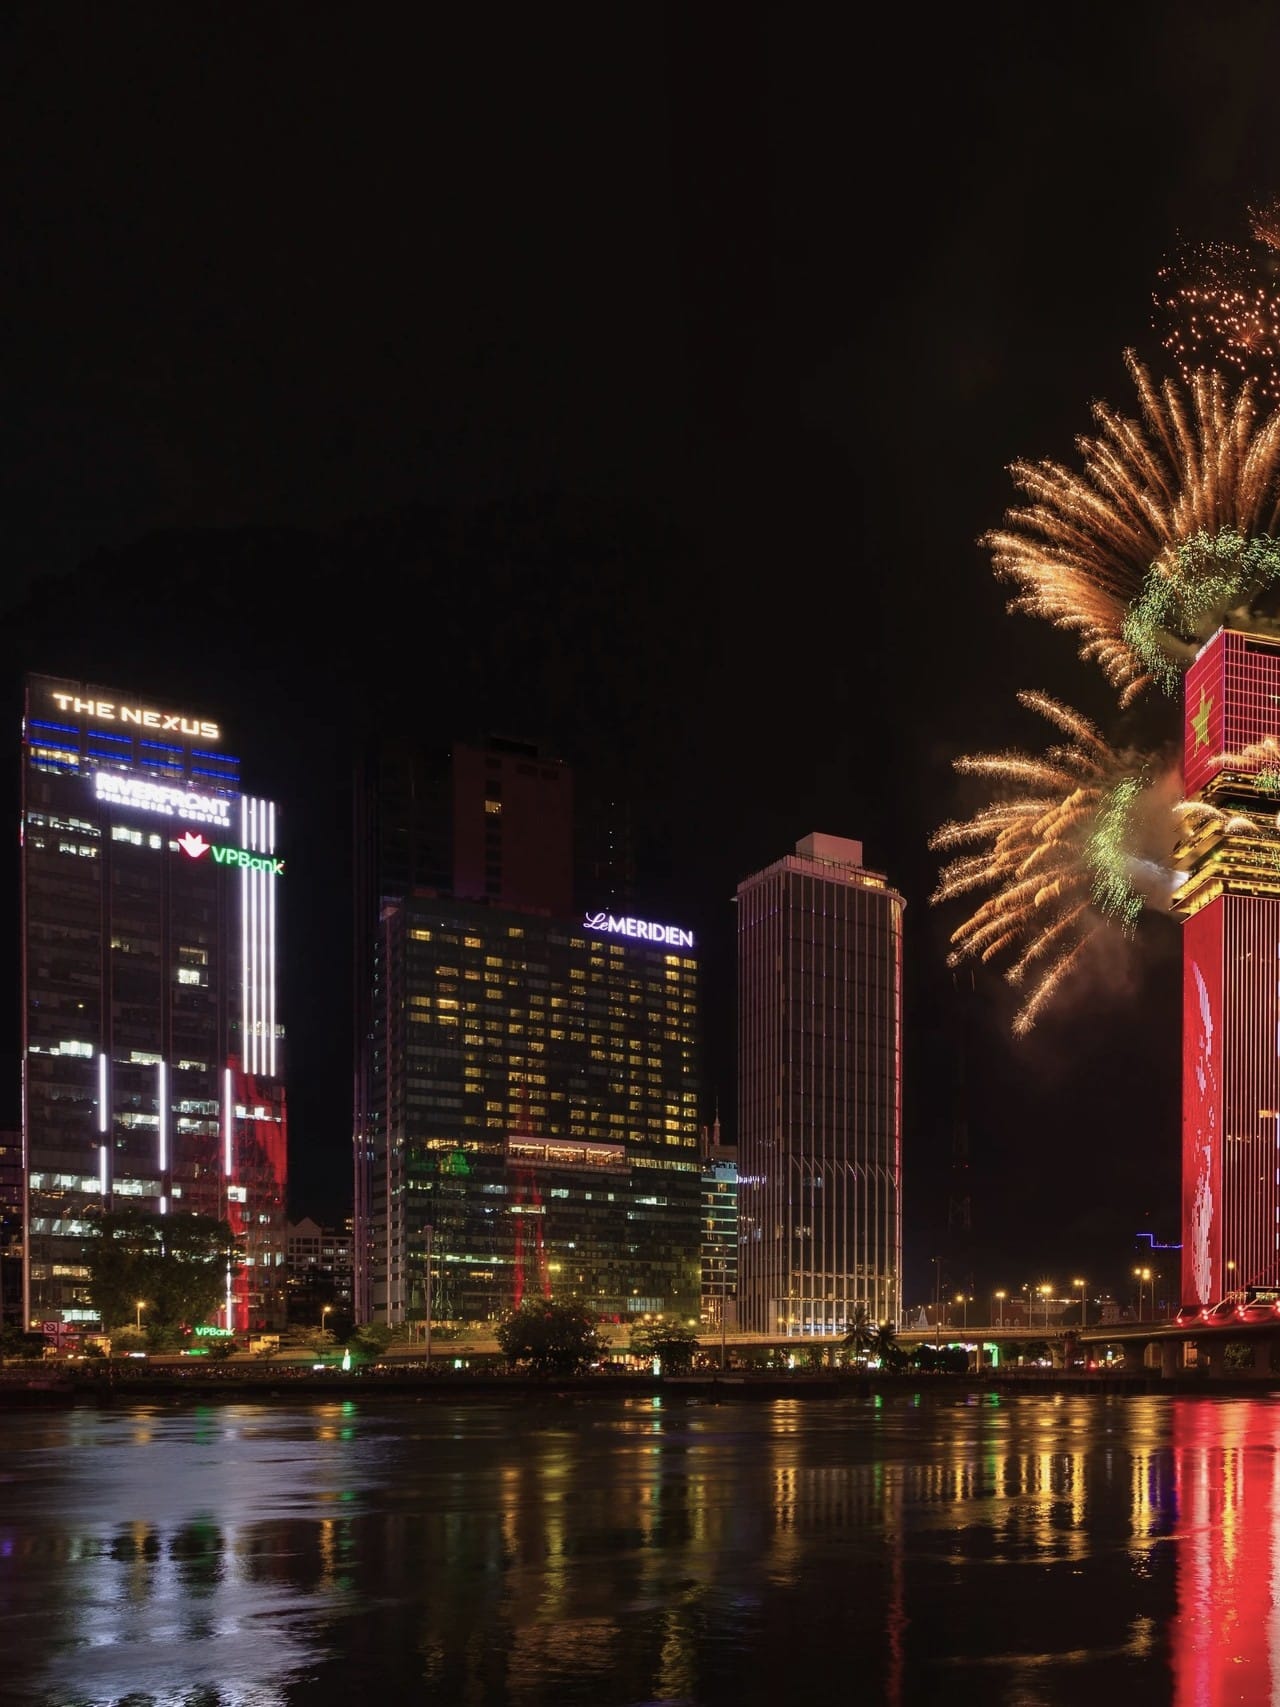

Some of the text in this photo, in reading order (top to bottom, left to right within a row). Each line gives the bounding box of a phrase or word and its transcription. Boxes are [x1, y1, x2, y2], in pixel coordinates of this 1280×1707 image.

[52, 692, 219, 739] THE NEXUS
[211, 845, 285, 875] VPBank
[195, 1327, 236, 1337] VPBank
